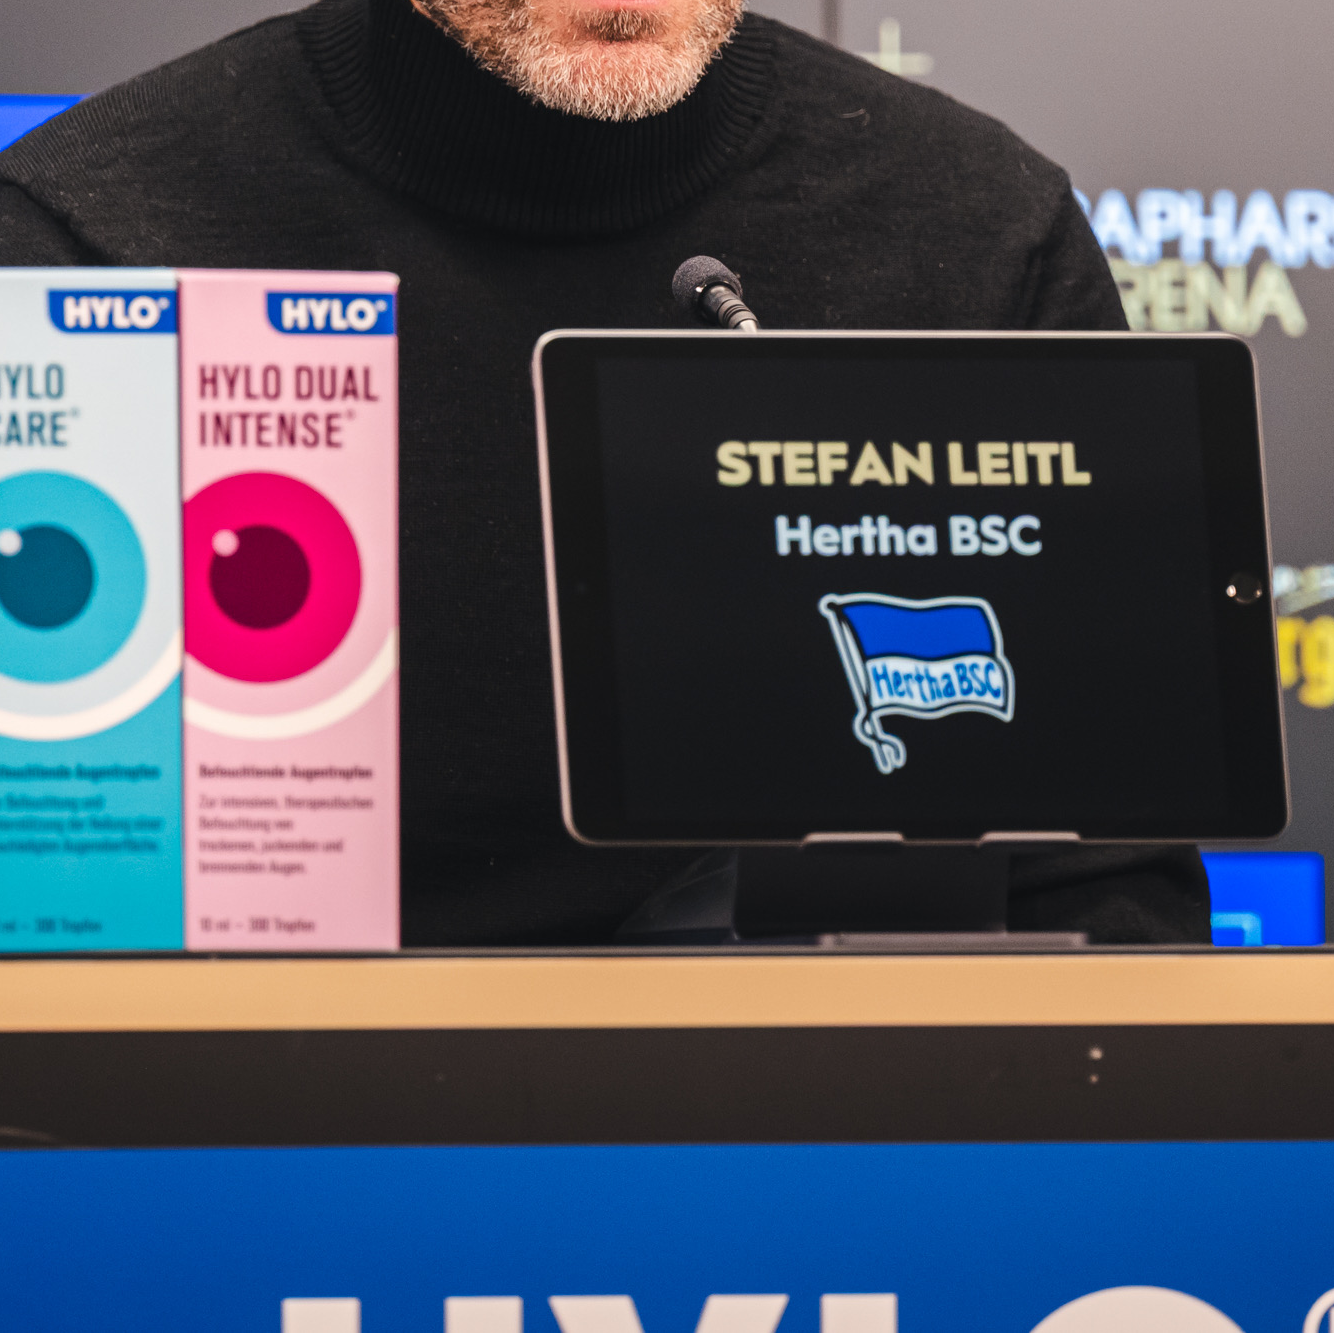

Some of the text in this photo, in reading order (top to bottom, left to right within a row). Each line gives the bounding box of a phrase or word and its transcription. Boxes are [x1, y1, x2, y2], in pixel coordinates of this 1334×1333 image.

[1106, 258, 1308, 338] RENA
[199, 365, 379, 402] HYLO DUAL
[716, 440, 1092, 487] STEFAN LEITL
[775, 515, 1043, 557] Hertha BSC
[871, 661, 1003, 706] Hertha BSC
